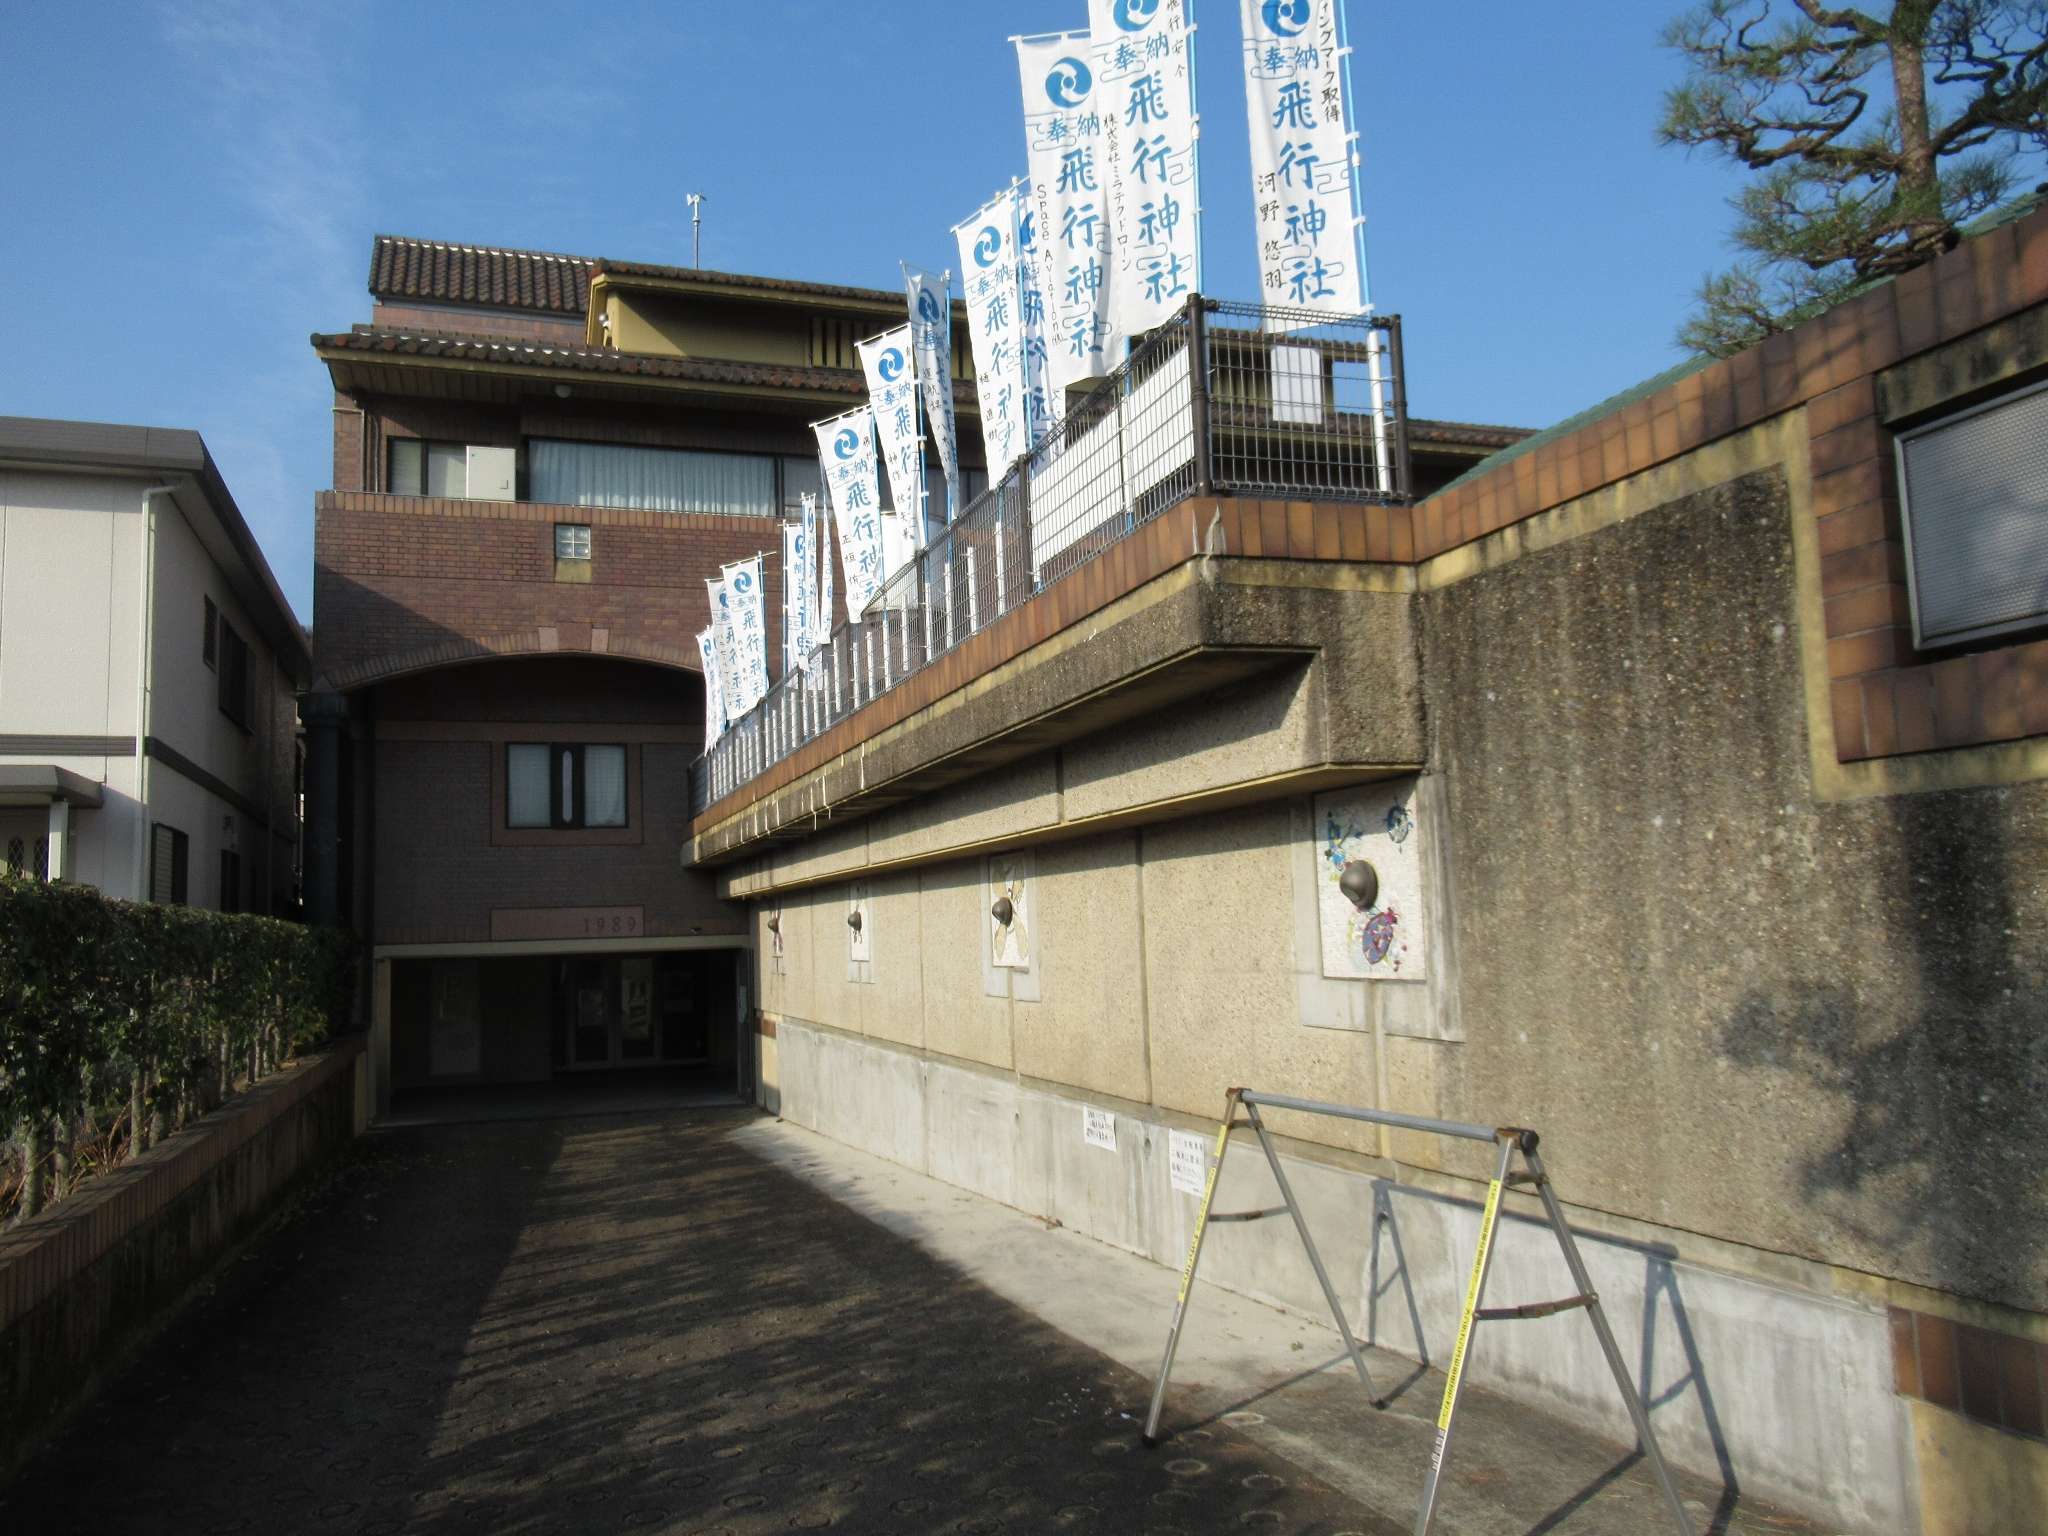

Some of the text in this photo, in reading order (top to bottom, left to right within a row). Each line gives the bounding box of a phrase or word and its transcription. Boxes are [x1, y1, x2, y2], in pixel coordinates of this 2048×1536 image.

[1113, 31, 1169, 72] 奉納
[1263, 43, 1319, 75] 奉納
[1047, 113, 1101, 144] 奉納
[1124, 70, 1188, 304] 飛行神社
[1056, 146, 1105, 358] 飛行神社
[1272, 80, 1336, 304] 飛行神社
